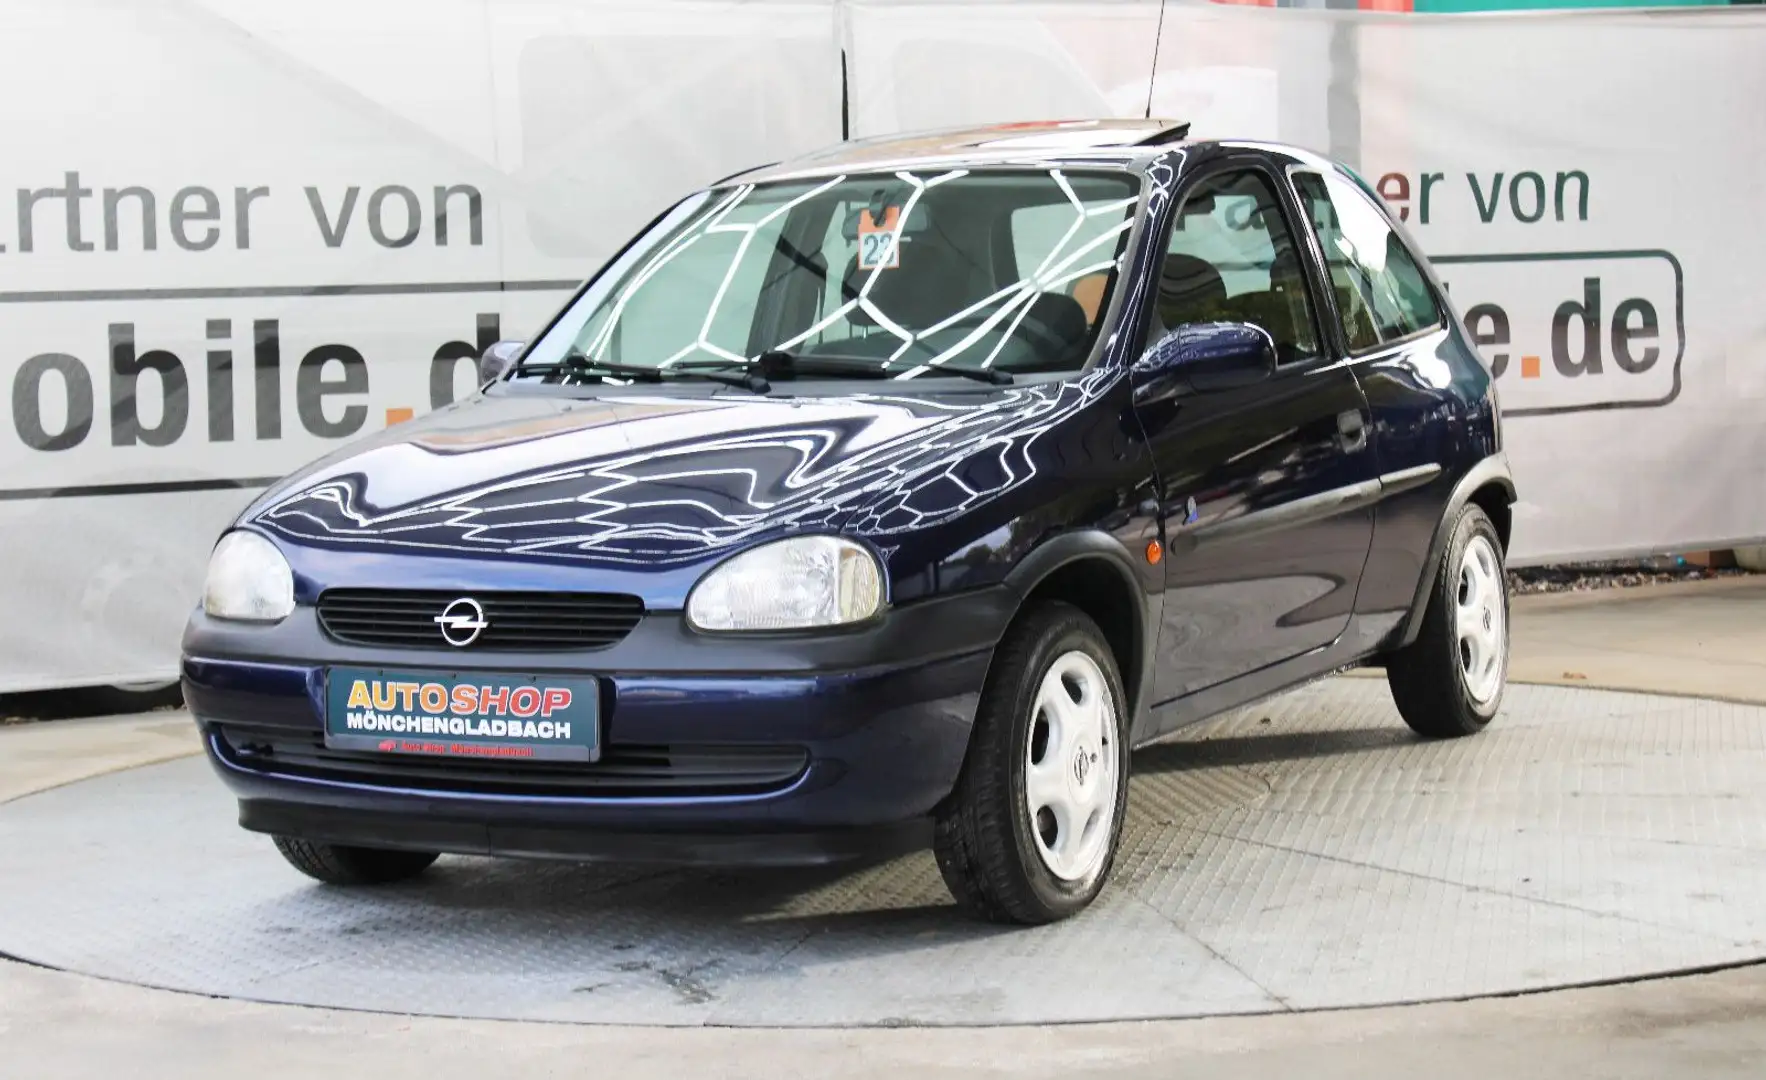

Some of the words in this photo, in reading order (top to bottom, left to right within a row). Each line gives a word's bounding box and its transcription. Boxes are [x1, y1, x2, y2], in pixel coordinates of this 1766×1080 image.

[0, 171, 269, 253] rtner
[304, 183, 483, 249] von
[1466, 169, 1589, 224] von
[1442, 277, 1660, 379] e.de
[346, 710, 571, 739] MÖNCHENGLADBACH
[347, 680, 572, 717] AUTOSHOP
